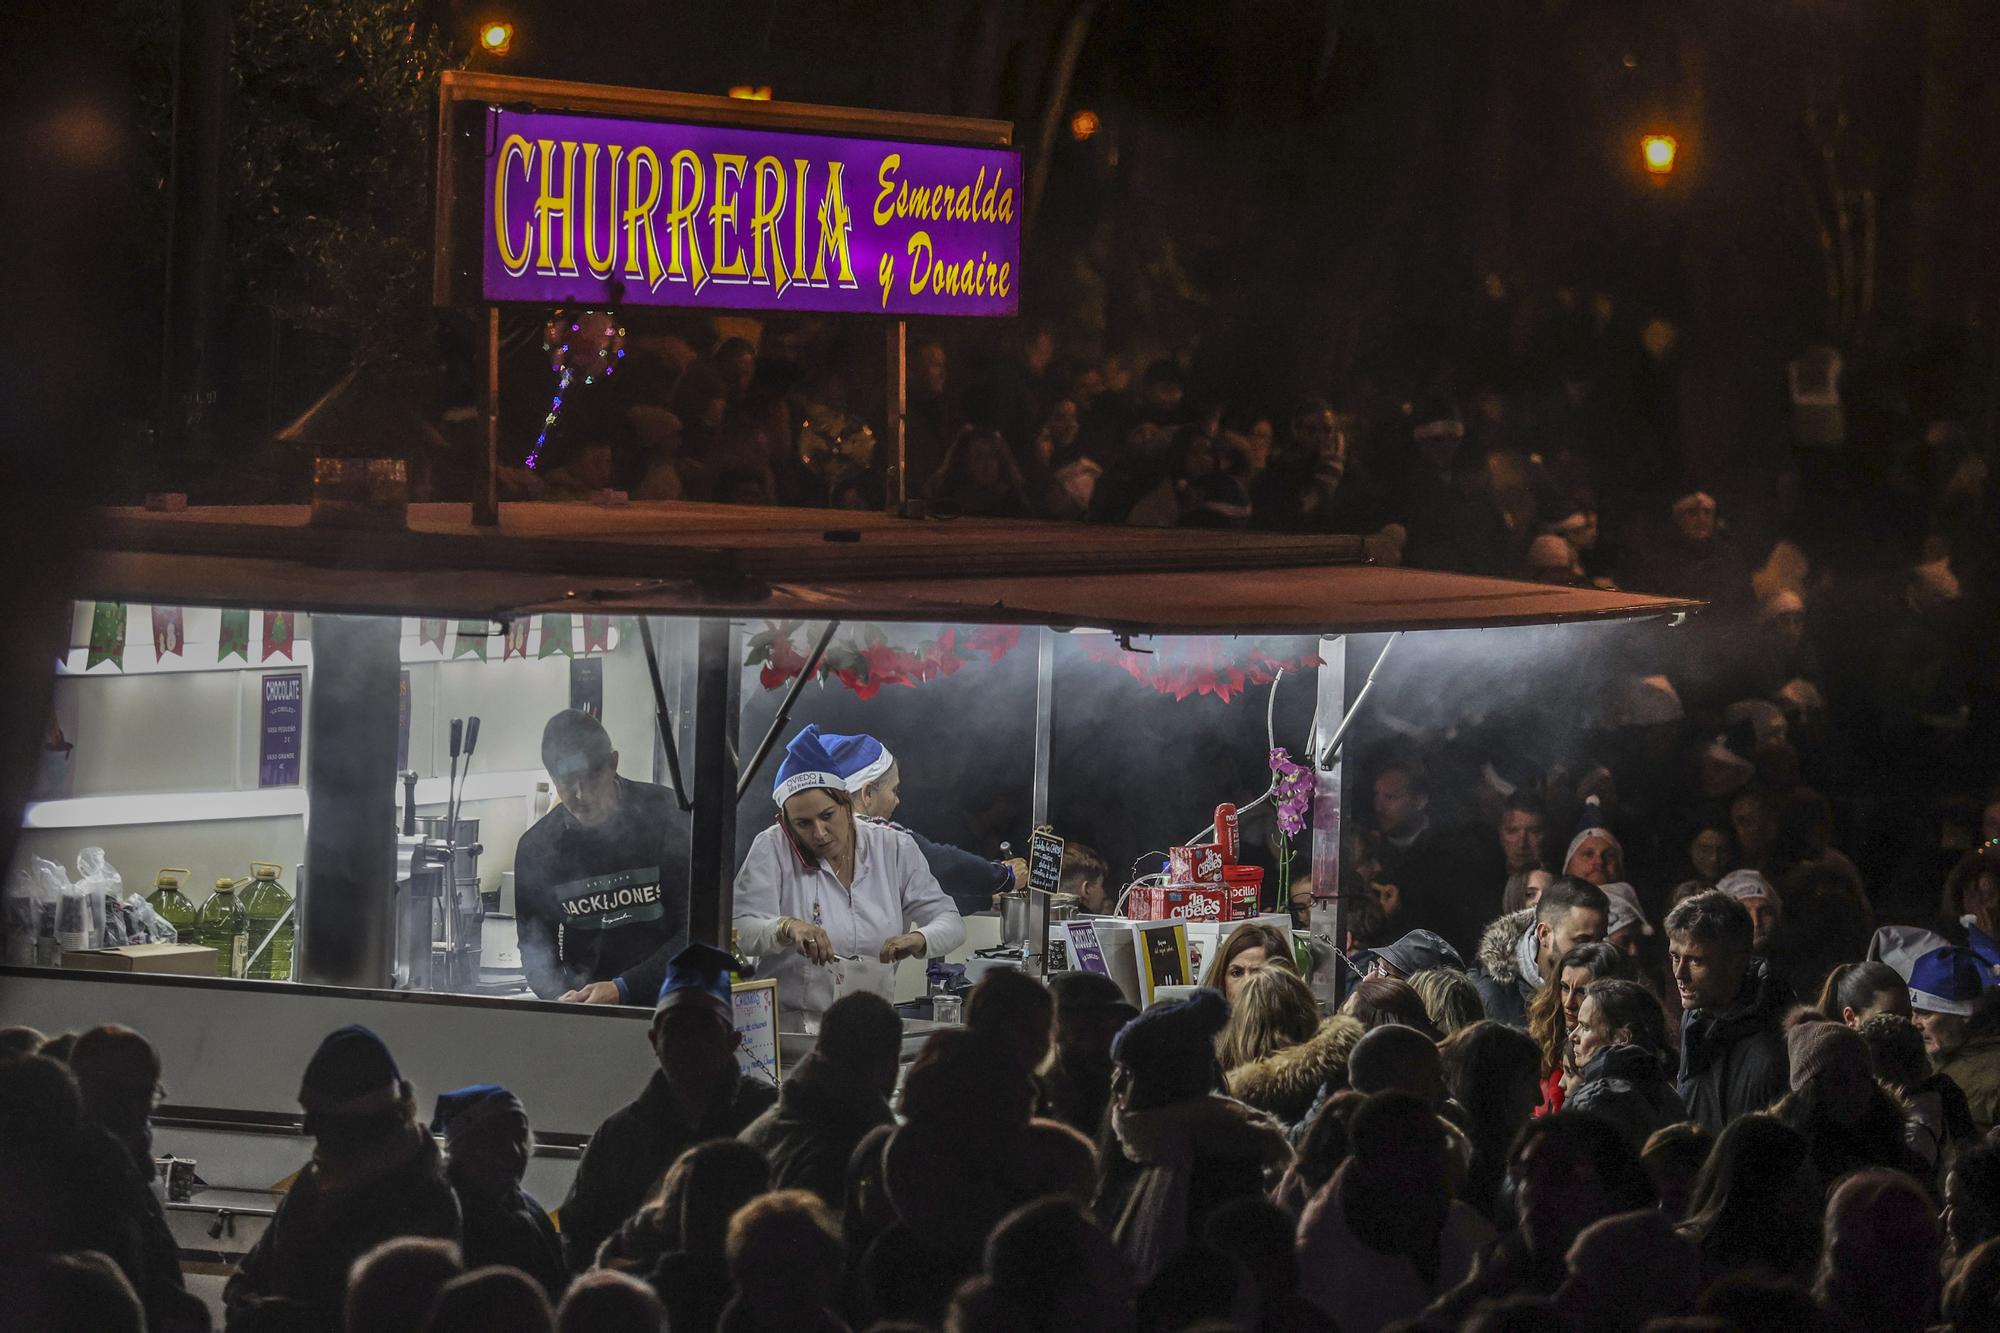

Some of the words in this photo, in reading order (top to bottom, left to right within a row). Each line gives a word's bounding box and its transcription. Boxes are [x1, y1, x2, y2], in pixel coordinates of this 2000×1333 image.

[873, 153, 1015, 226] Esmeralda
[494, 133, 859, 299] CHURRERIA
[879, 250, 895, 309] y
[907, 231, 1012, 298] Donaire
[266, 680, 300, 701] CHOCOLATE
[787, 773, 816, 786] OVIEDO
[1170, 898, 1221, 920] Cibeles
[1188, 892, 1204, 907] la
